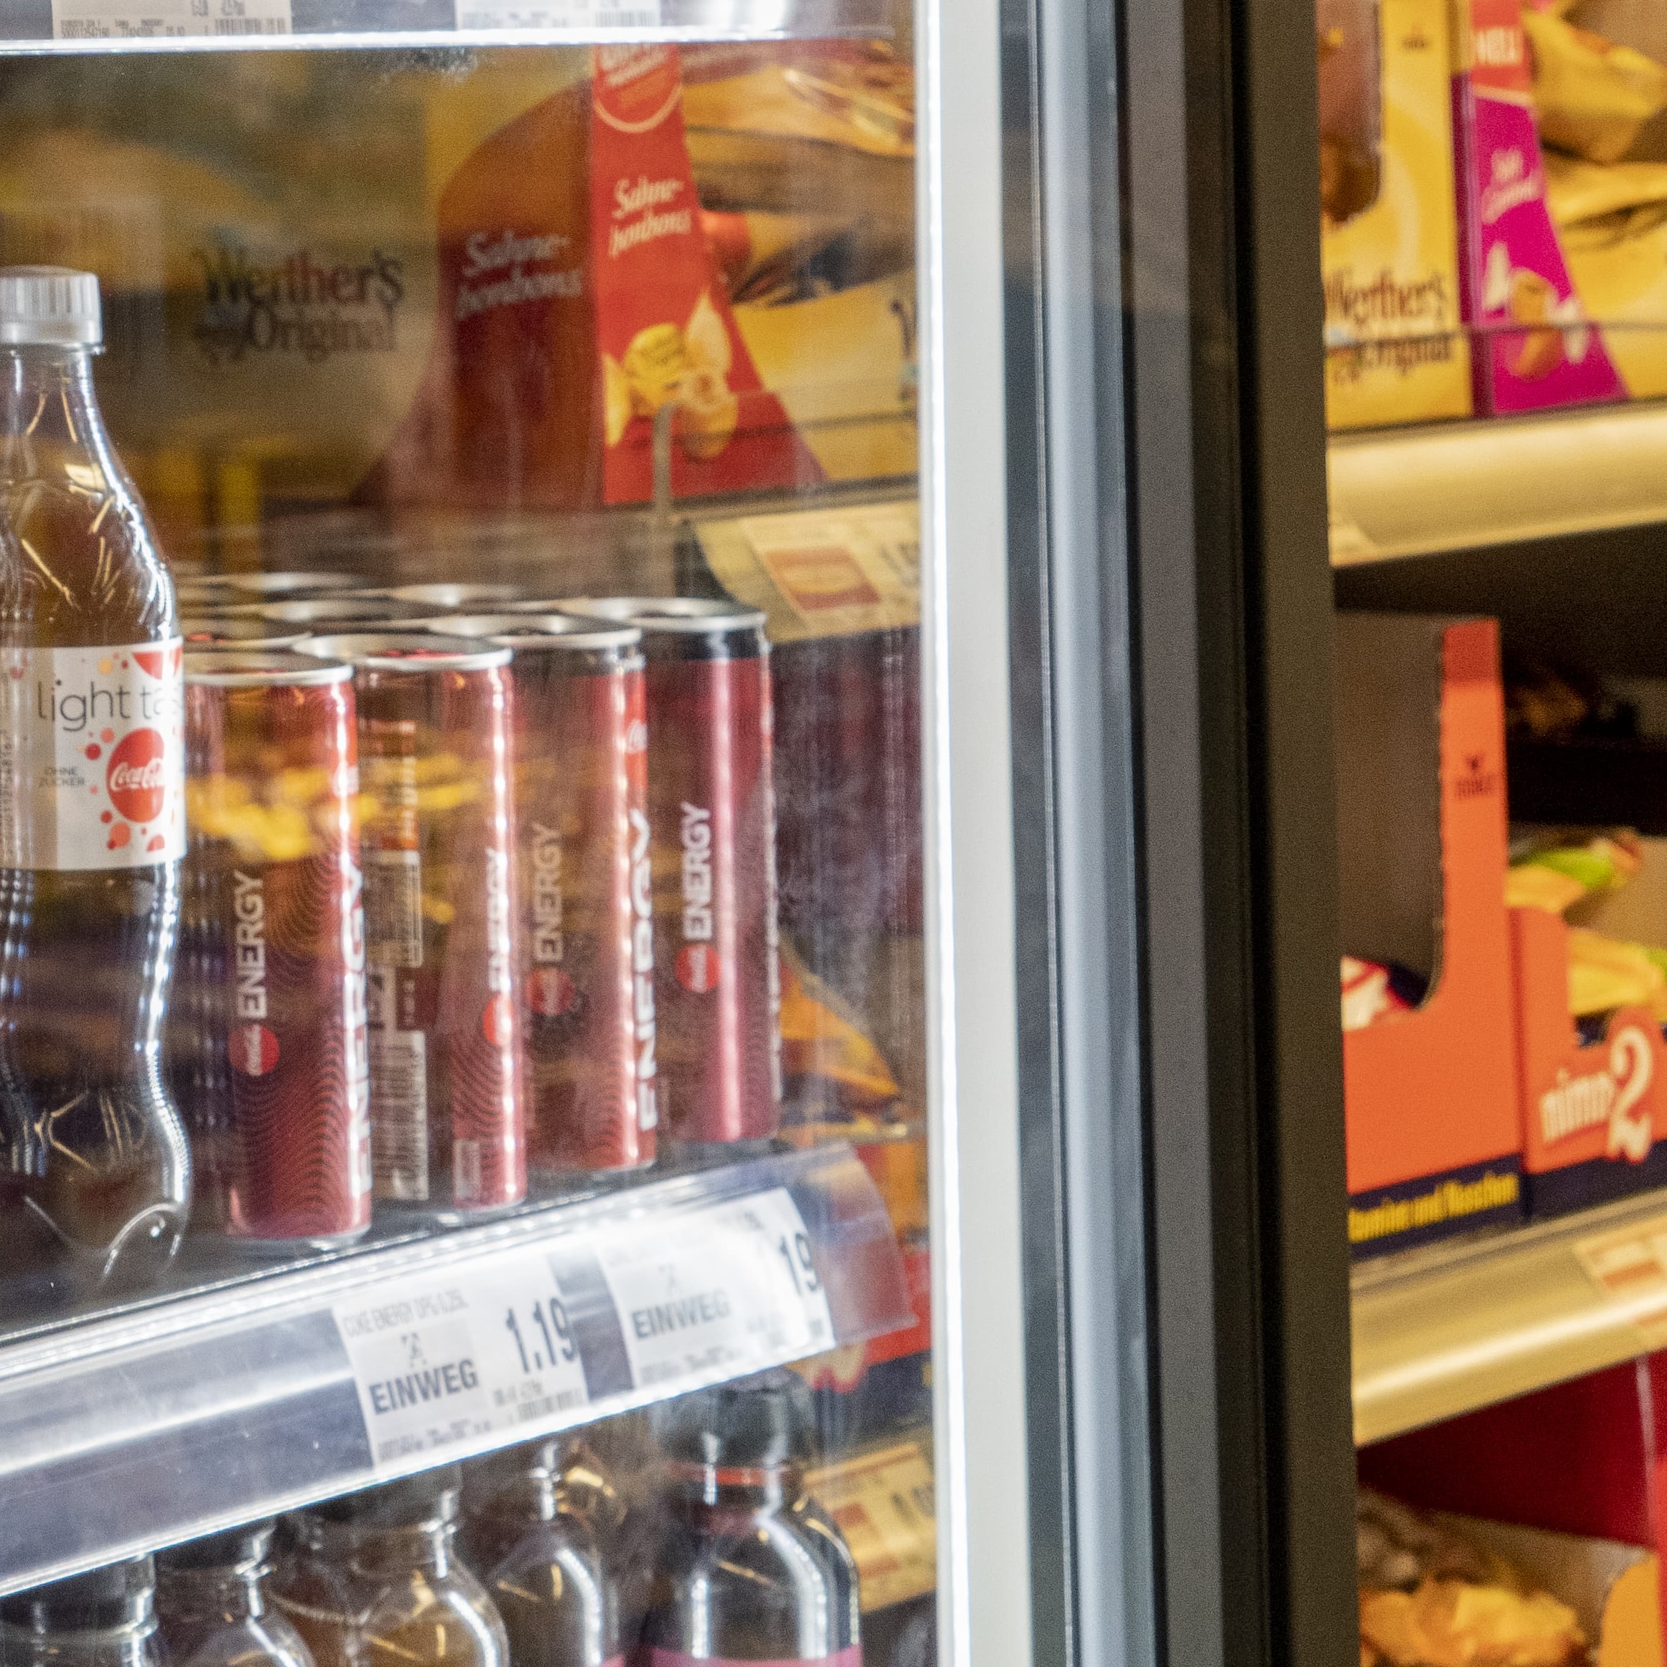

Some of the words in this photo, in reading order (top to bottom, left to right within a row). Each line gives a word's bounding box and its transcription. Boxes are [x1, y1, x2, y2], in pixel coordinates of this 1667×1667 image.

[37, 678, 131, 732] light
[531, 822, 564, 963] ENERGY
[681, 800, 714, 942] ENERGY
[232, 870, 267, 1020] ENERGY
[505, 1295, 578, 1375] 1.19
[630, 1288, 731, 1341] EINWEG
[368, 1359, 479, 1416] EINWEG
